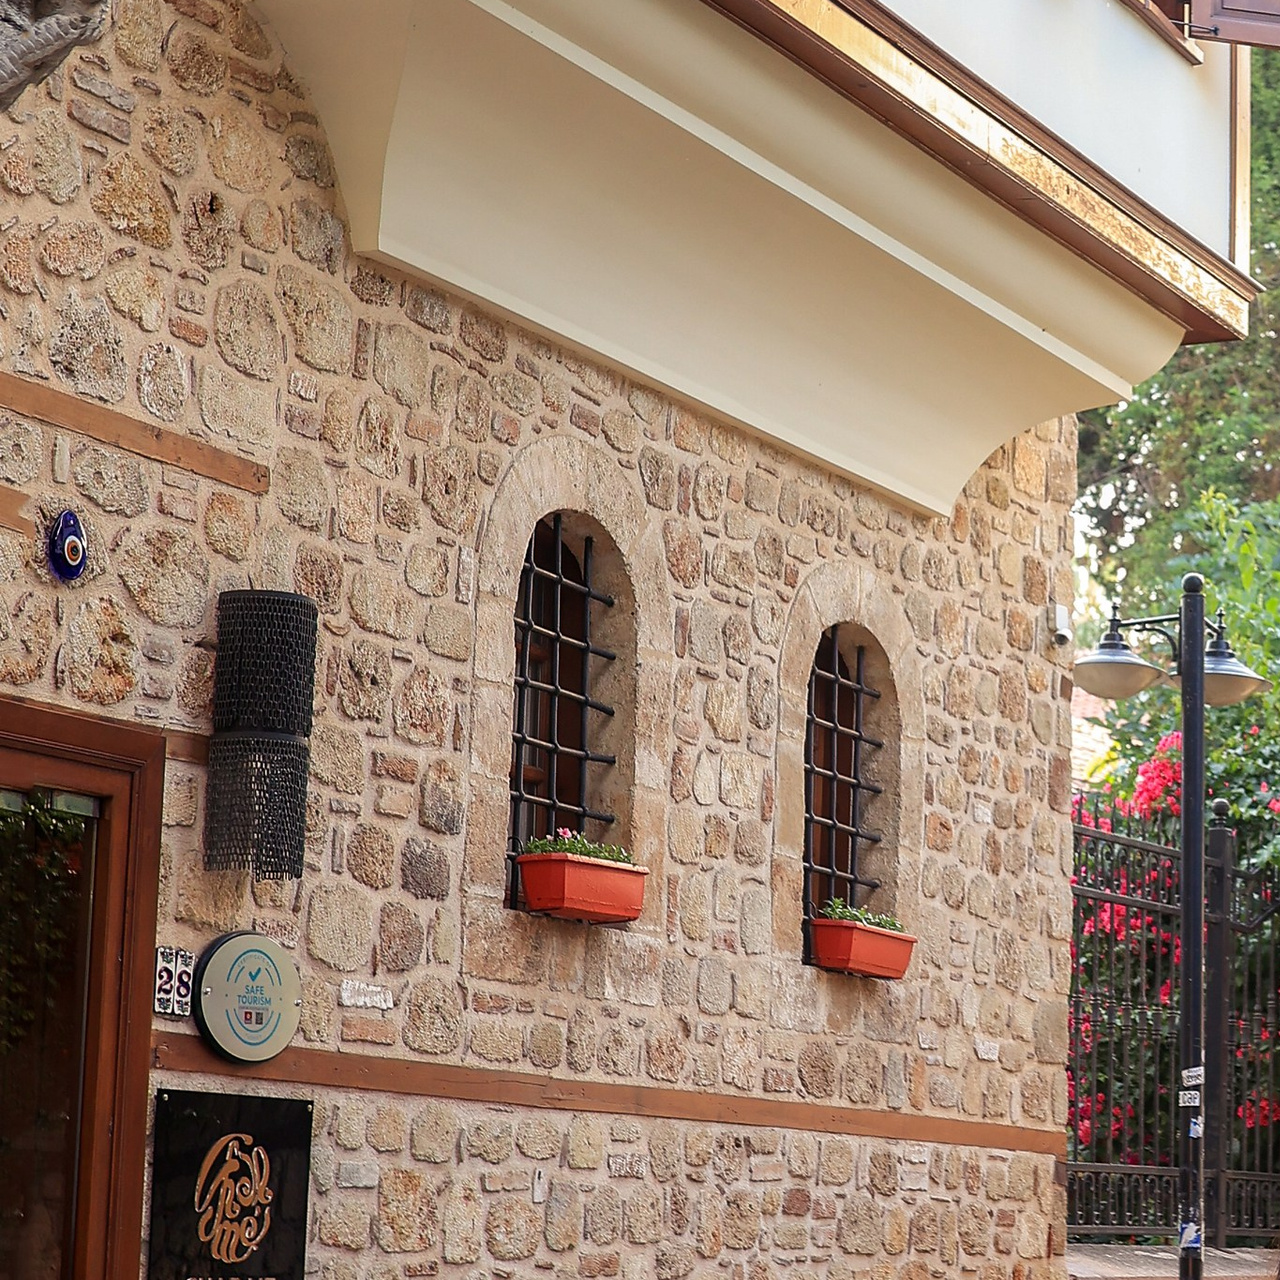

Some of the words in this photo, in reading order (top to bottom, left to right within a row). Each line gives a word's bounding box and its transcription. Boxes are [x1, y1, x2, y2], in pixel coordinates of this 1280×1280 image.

[157, 966, 192, 998] 28
[245, 985, 264, 995] SAFE
[237, 995, 271, 1006] TOURISM
